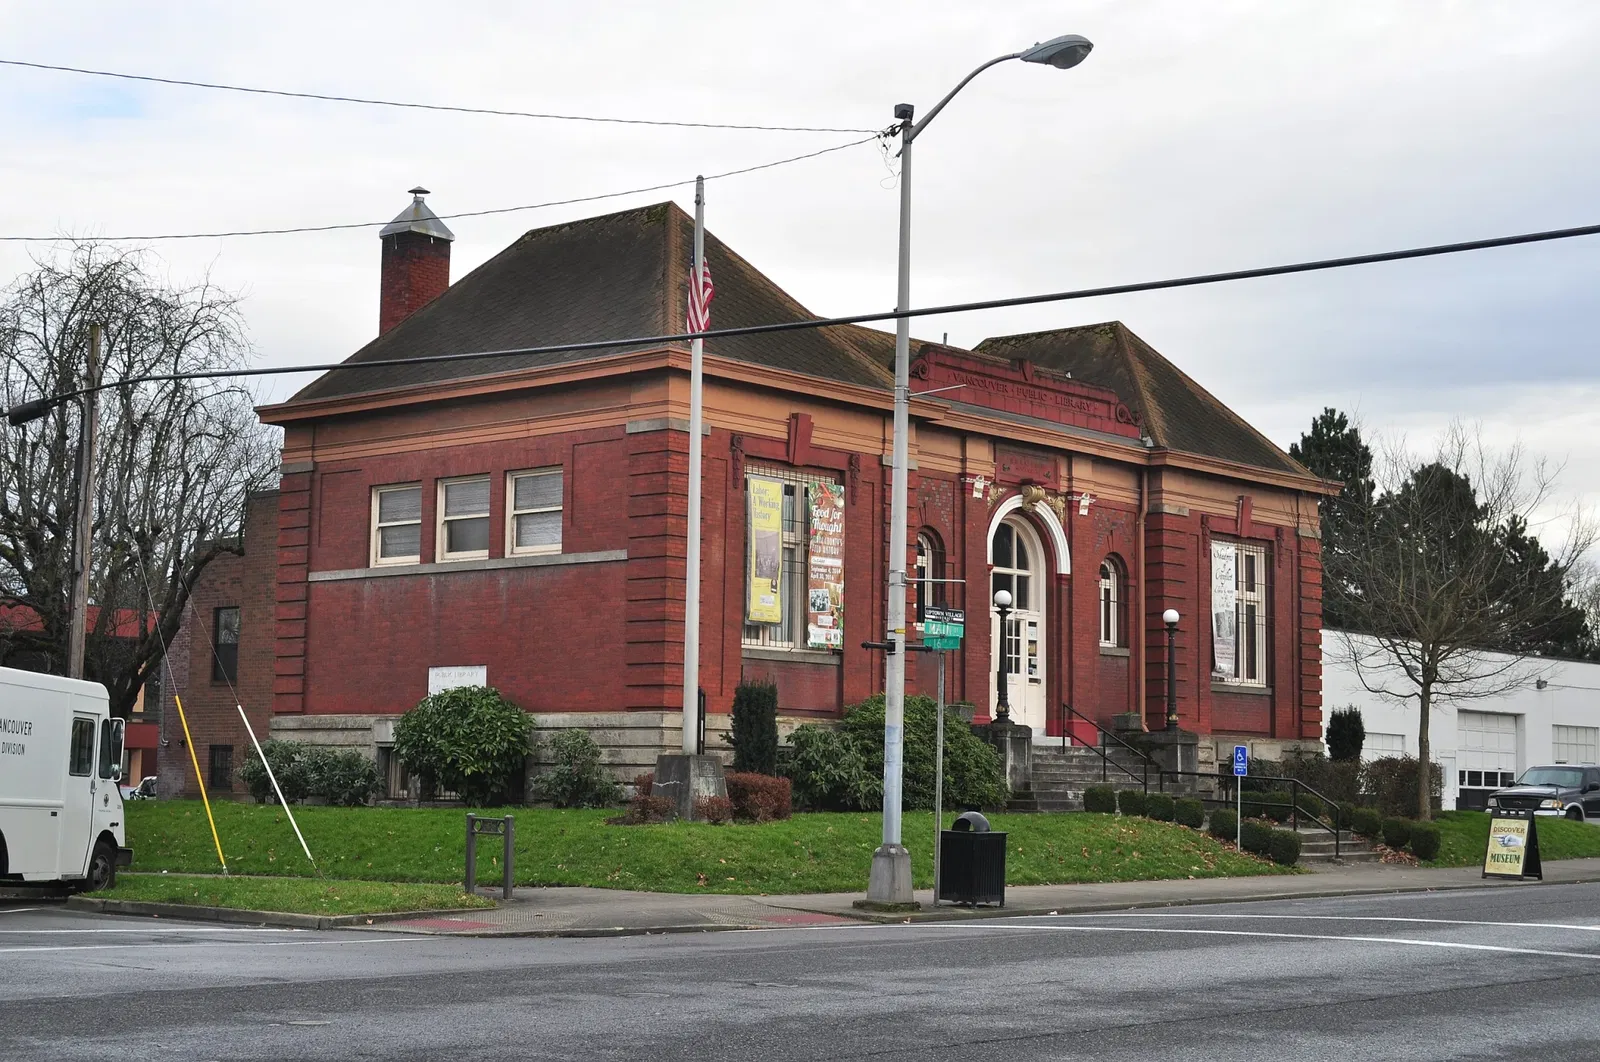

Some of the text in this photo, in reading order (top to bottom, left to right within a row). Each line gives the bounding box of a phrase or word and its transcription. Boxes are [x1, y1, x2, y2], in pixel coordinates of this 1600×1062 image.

[952, 372, 1093, 412] VANCOUVER PUBLIC LIBRARY
[812, 504, 843, 522] Food for
[812, 517, 842, 535] Thought
[929, 623, 952, 636] MAIN
[2, 741, 26, 756] DIVISION
[1493, 826, 1526, 834] DISCOVER
[1490, 853, 1521, 864] MUSEUM
